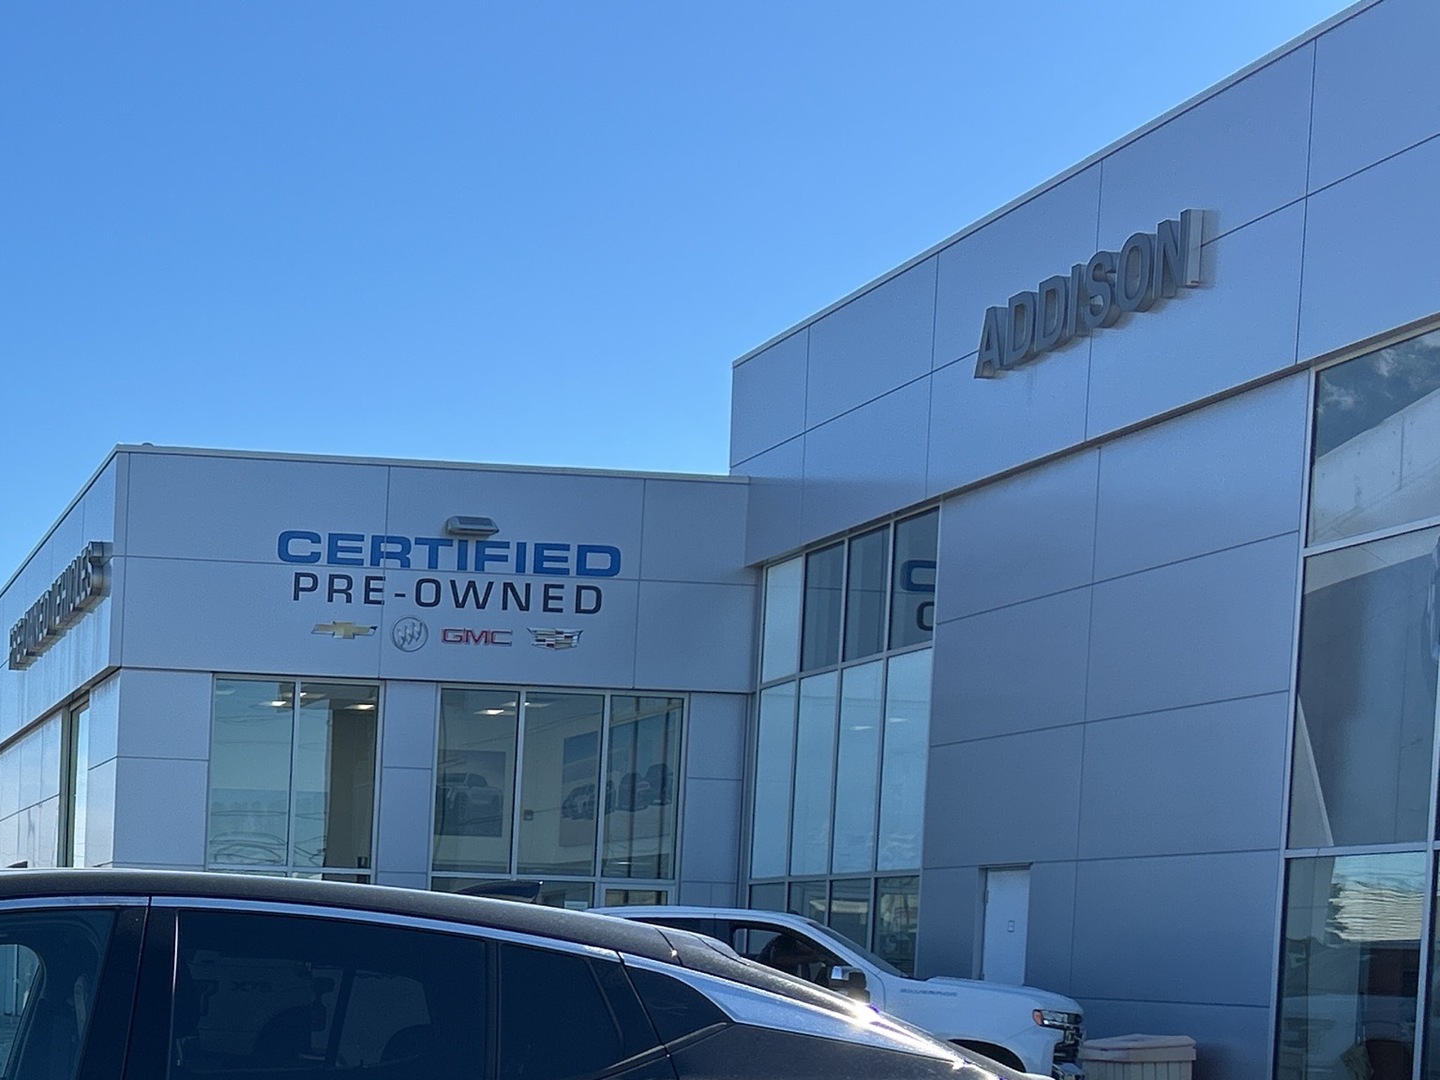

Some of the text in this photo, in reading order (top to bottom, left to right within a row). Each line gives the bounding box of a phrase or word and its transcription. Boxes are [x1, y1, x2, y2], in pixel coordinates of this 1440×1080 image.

[974, 208, 1204, 379] ADDISON
[277, 530, 622, 578] CERTIFIED
[292, 571, 603, 615] PRE-OWNED
[441, 627, 513, 648] GMC
